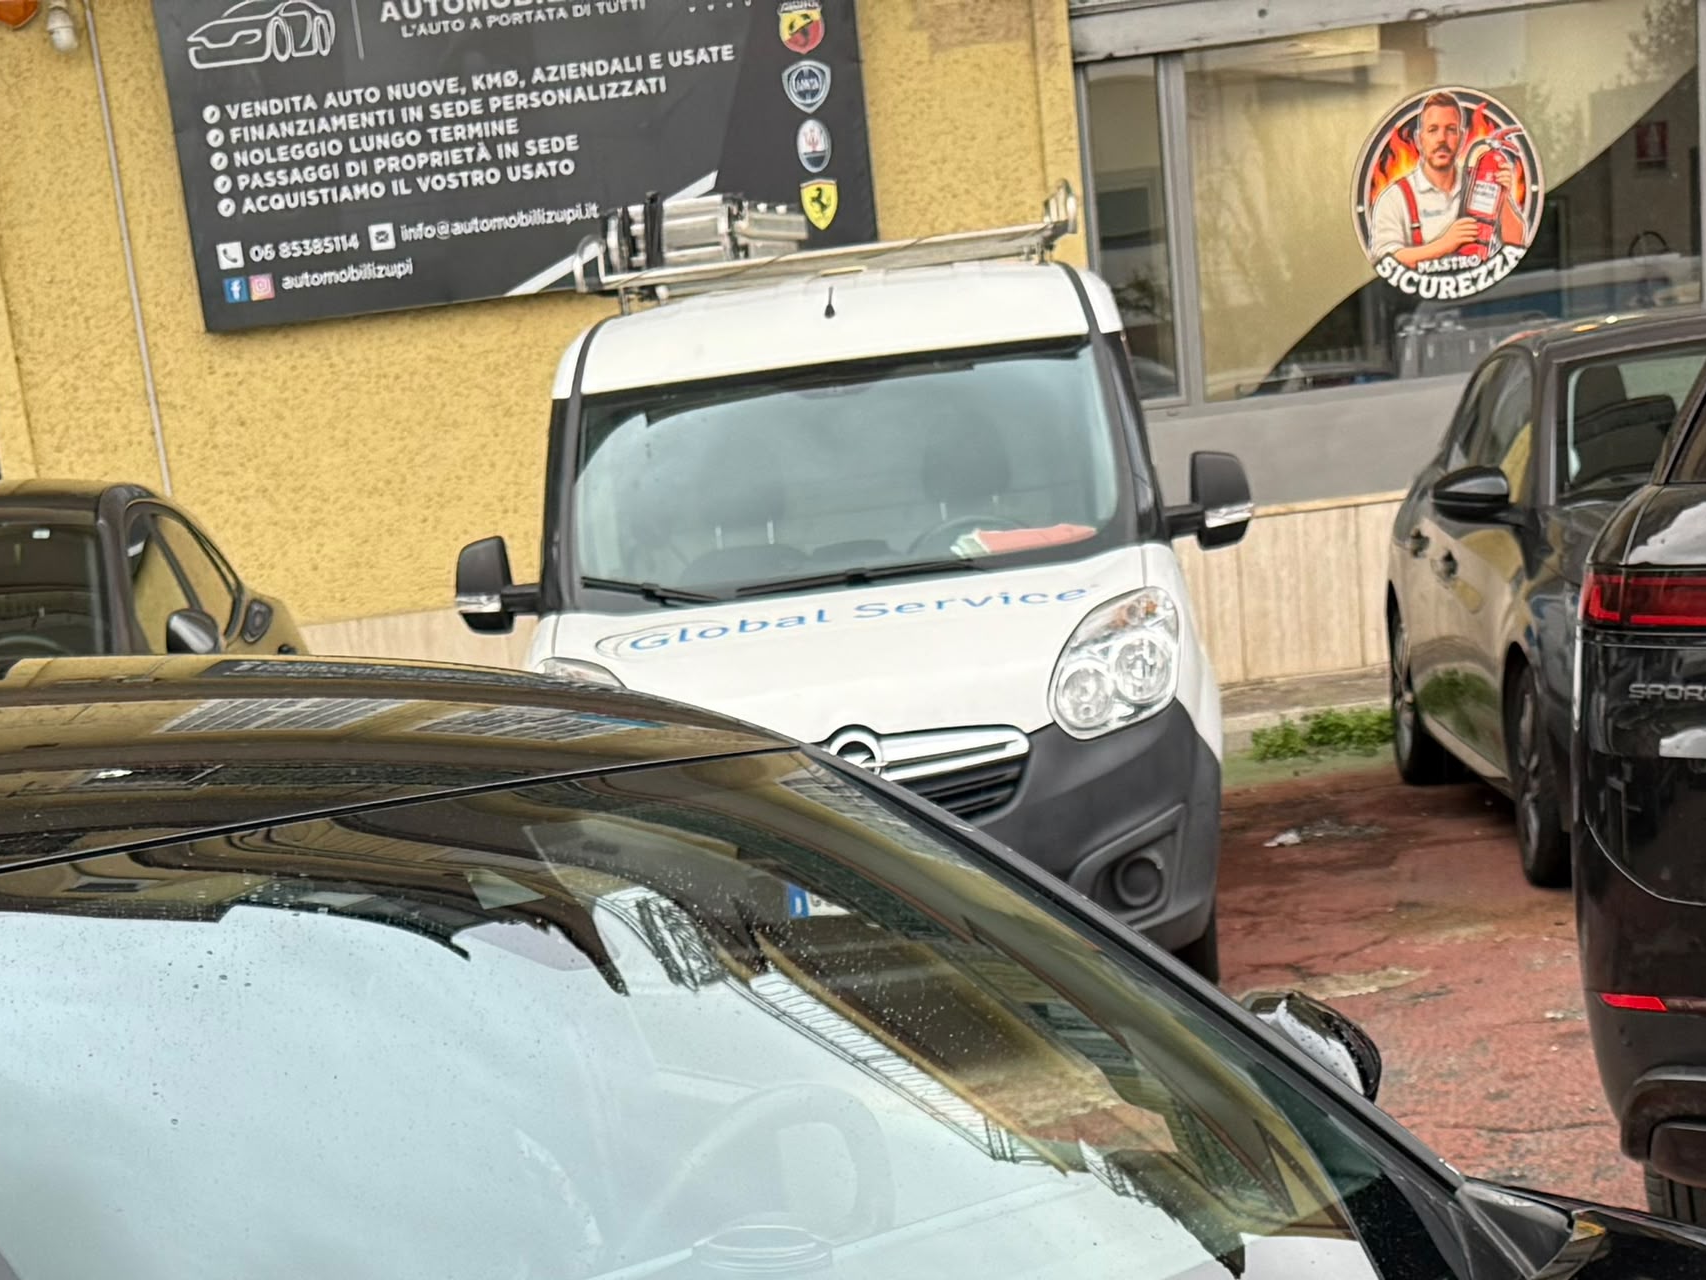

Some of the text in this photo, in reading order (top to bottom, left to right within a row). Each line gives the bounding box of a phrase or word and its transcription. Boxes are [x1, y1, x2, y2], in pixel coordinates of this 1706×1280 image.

[401, 19, 465, 38] L'AUTO
[469, 17, 483, 30] A
[486, 7, 569, 29] PORTATA
[572, 3, 591, 18] DI
[225, 94, 318, 120] VENDITA
[324, 86, 381, 109] AUTO
[387, 75, 467, 101] NUOVE,
[531, 55, 643, 84] AZIENDALI
[649, 52, 663, 70] E
[667, 44, 736, 67] USATE
[229, 75, 668, 145] FINANZIAMENTI IN SEDE PERSONALIZZATI
[233, 117, 520, 168] NOLEGGIO LUNGO TERMINE
[237, 133, 581, 192] PASSAGGI DI PROPRIETÀ IN SEDE
[241, 157, 577, 215] ACQUISTIAMO IL VOSTRO USATO
[249, 243, 276, 263] 06
[1375, 244, 1528, 300] SICUREZZA
[629, 584, 1089, 653] Global Service
